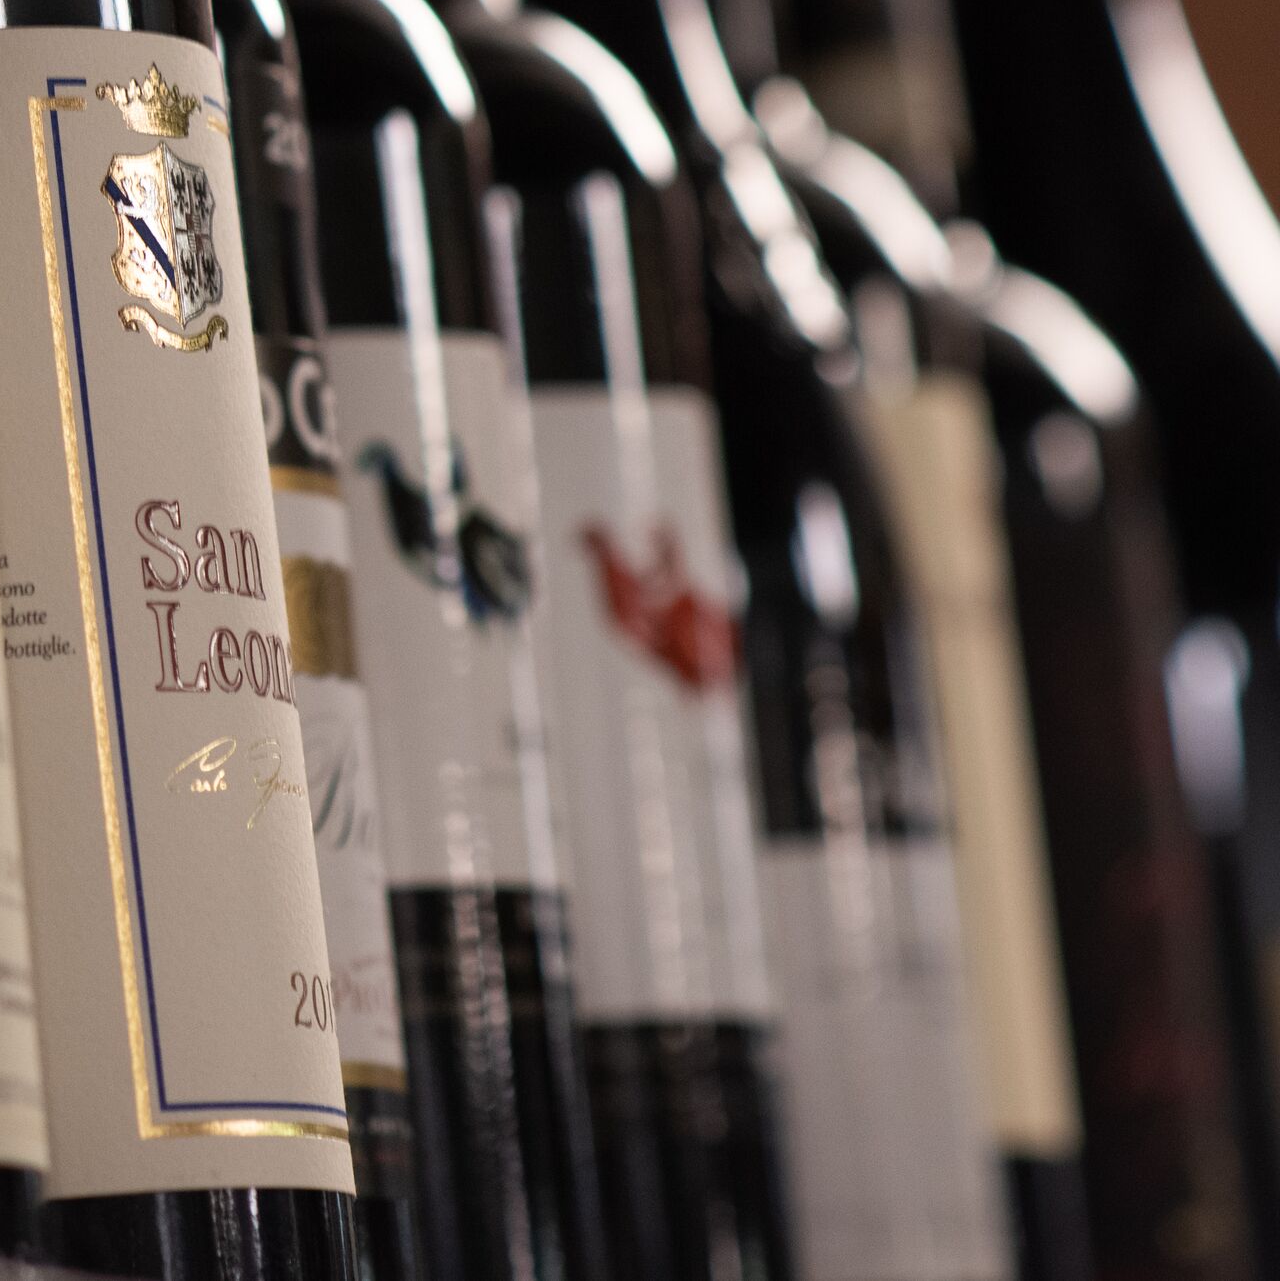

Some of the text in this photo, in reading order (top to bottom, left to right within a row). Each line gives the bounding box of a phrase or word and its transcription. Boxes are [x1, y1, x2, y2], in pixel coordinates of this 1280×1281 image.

[135, 499, 266, 601] San
[3, 633, 77, 662] bottiglie.
[146, 601, 297, 708] Leon
